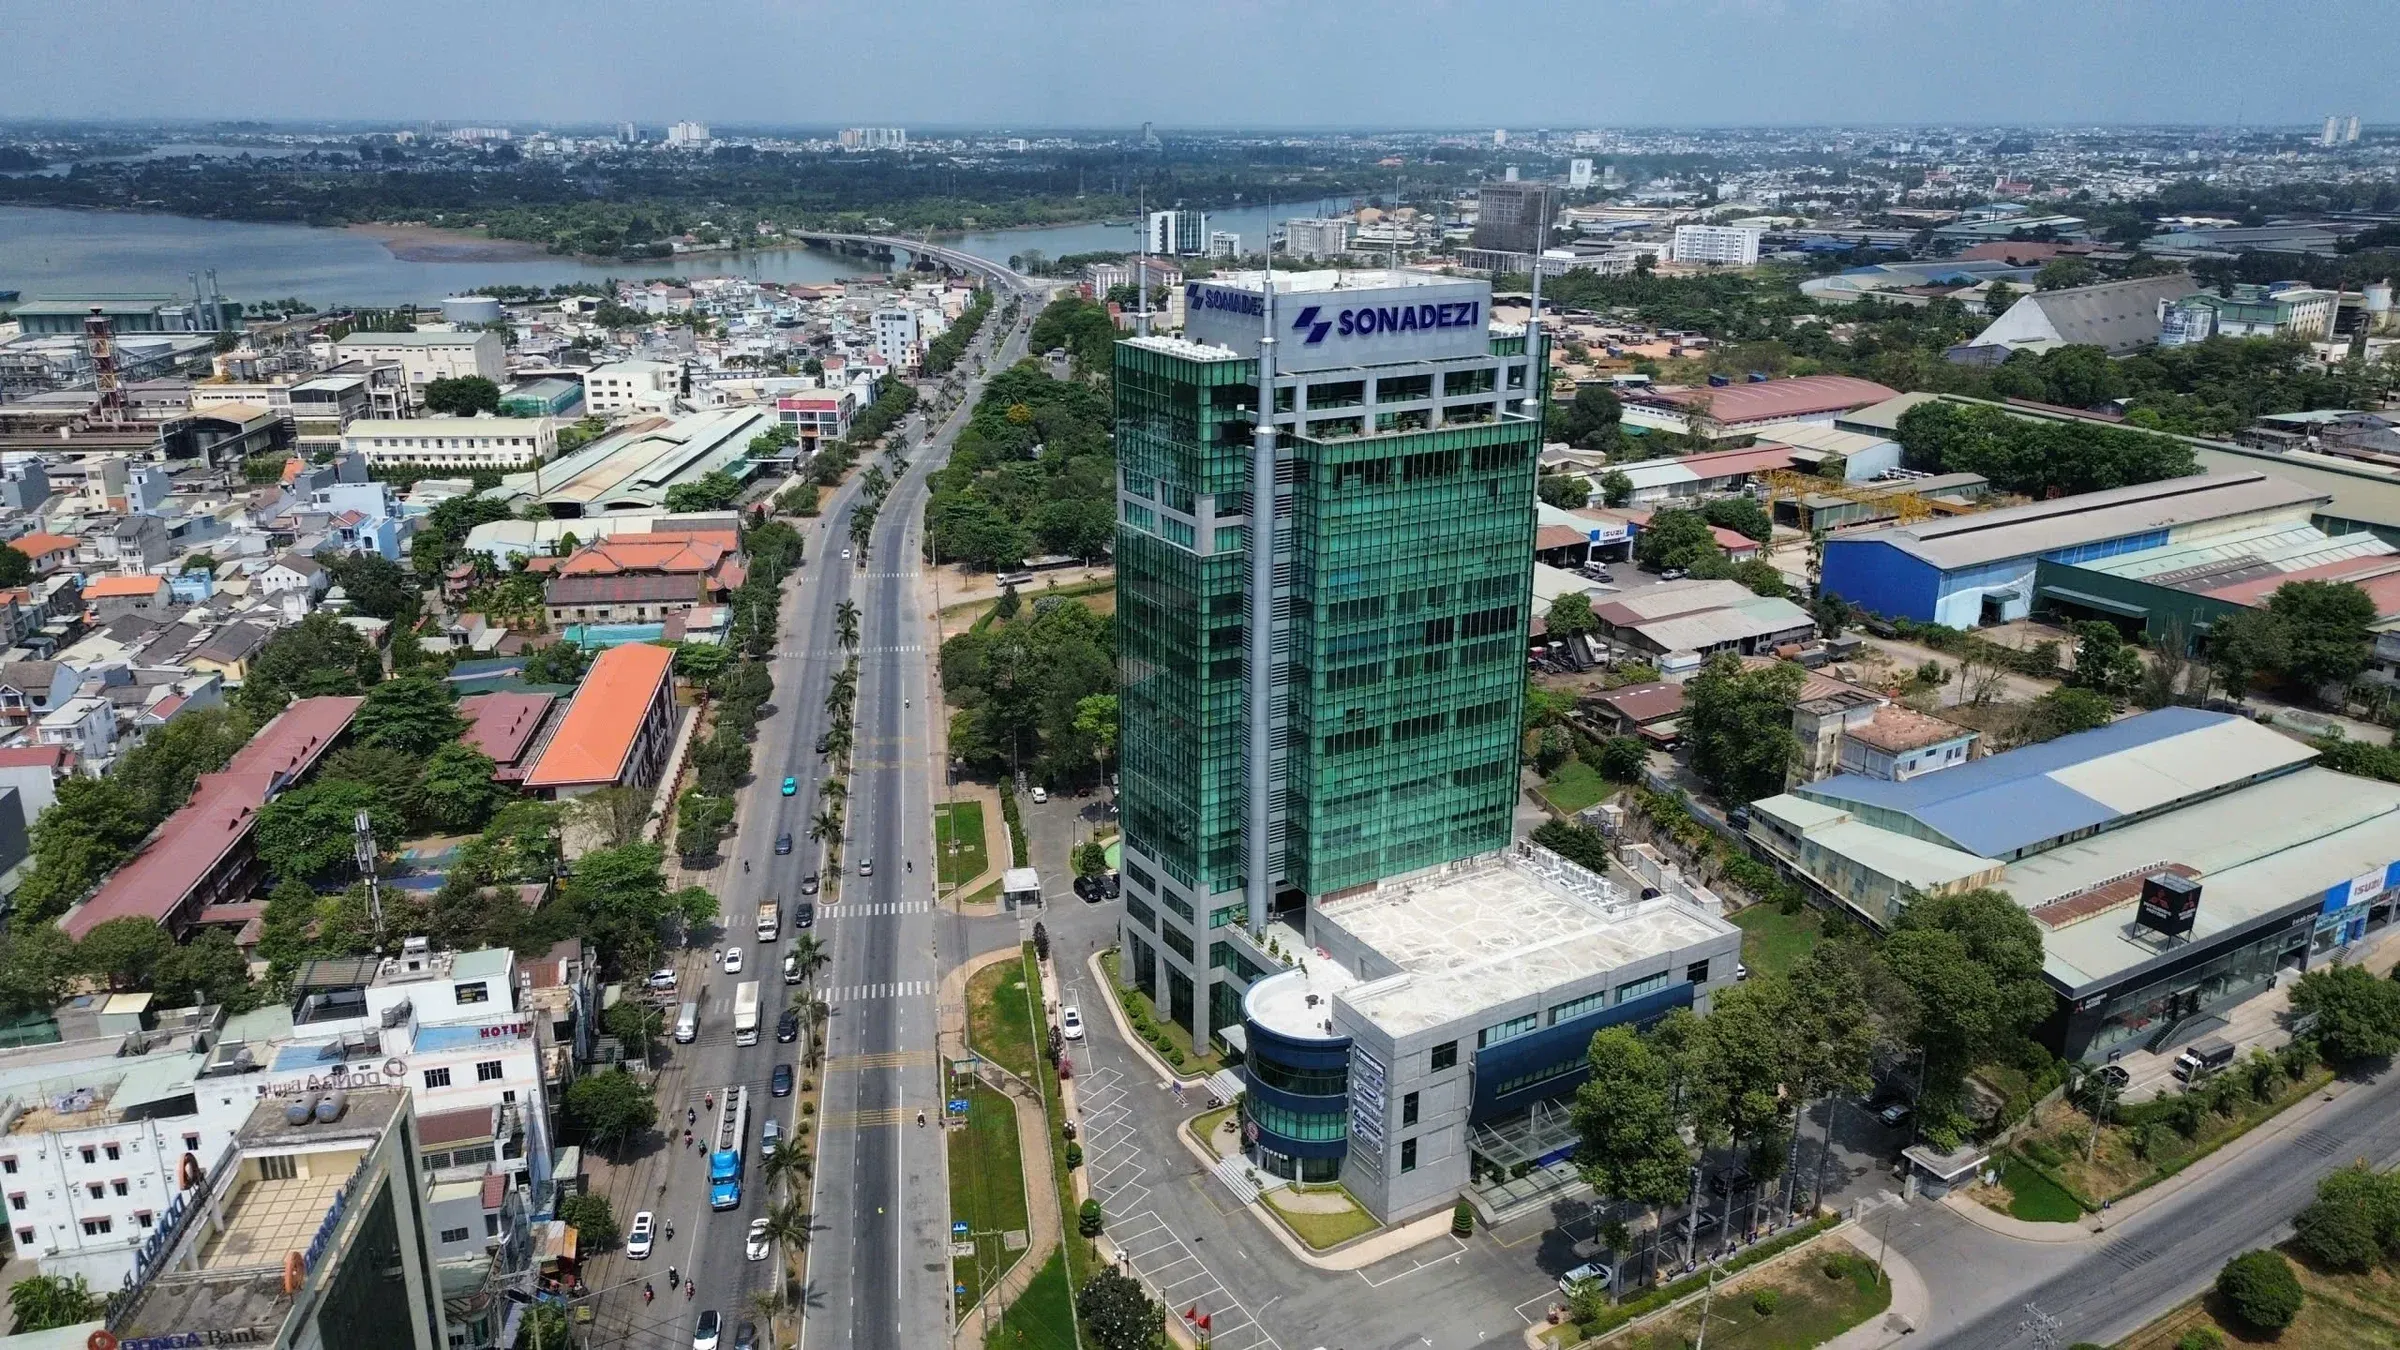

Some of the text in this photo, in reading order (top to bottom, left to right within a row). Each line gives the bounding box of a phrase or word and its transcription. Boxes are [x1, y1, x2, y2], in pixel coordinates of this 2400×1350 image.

[1205, 288, 1274, 318] SONADEZ
[1338, 301, 1479, 335] SONADEZI
[1603, 529, 1624, 537] ISUZU
[2353, 877, 2383, 896] ISUZU
[480, 1022, 527, 1038] HOTEL
[1260, 1145, 1288, 1161] COFFEE
[207, 1328, 264, 1347] Bank
